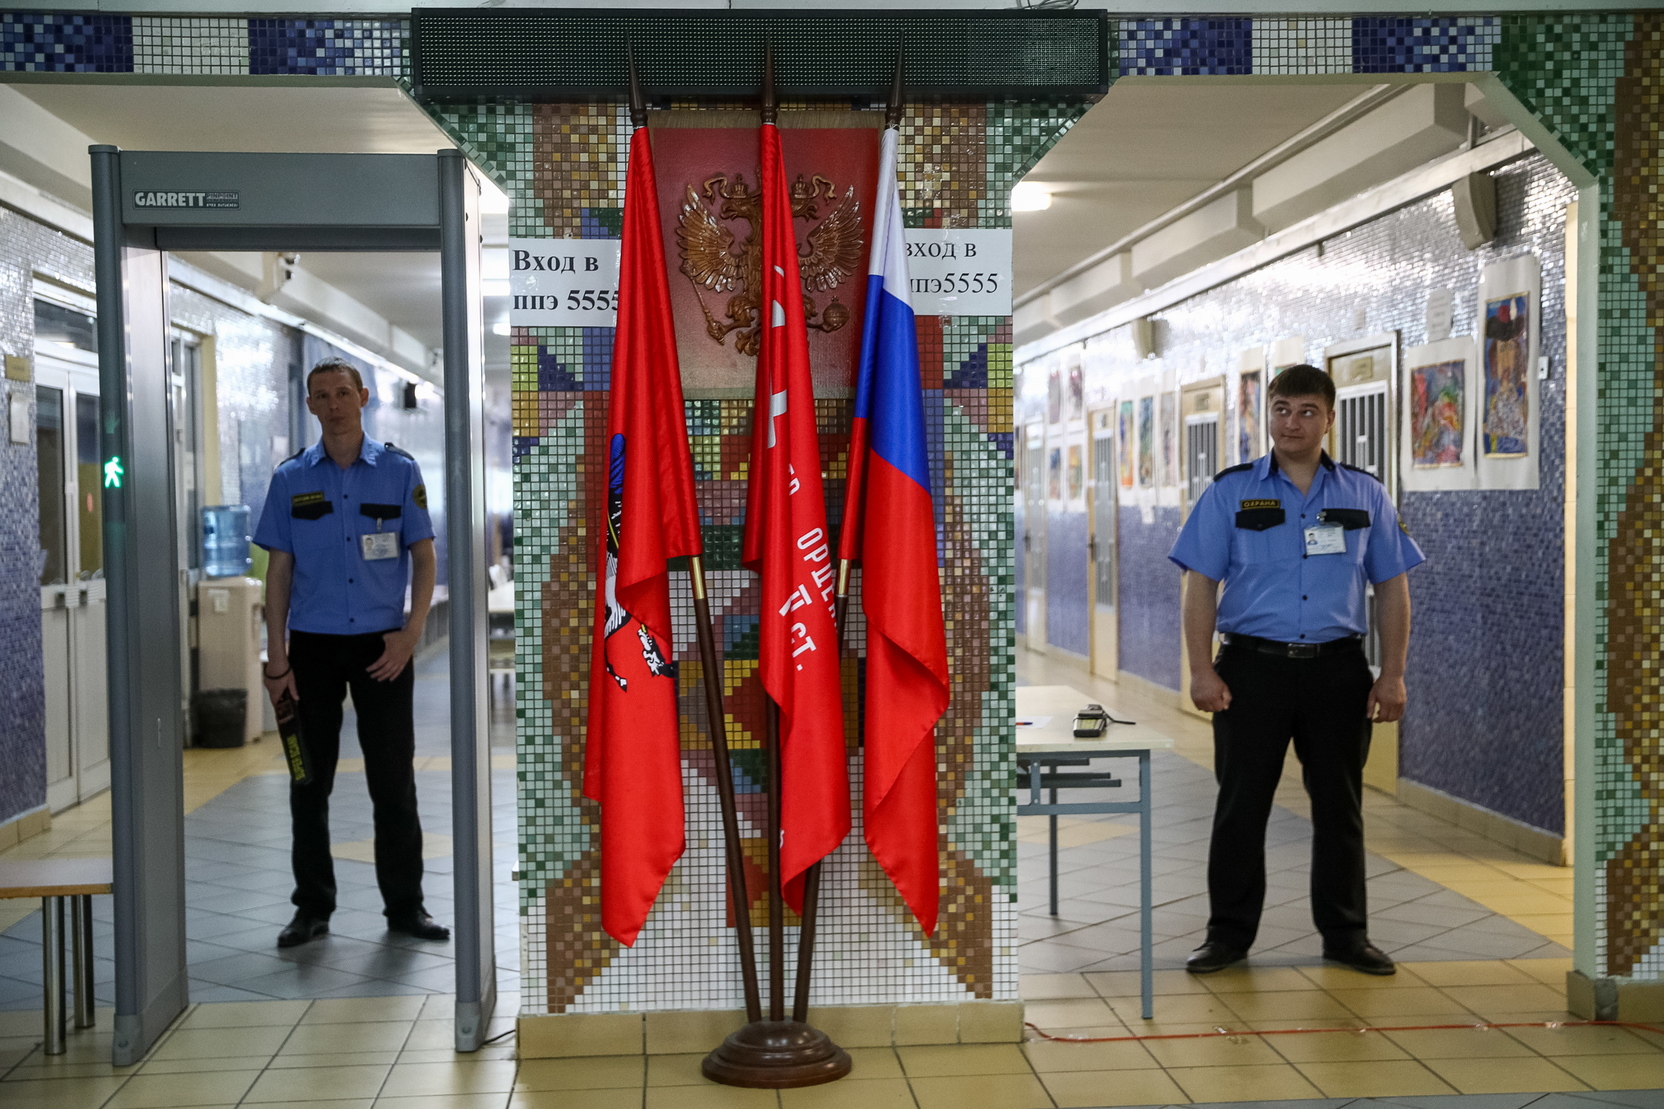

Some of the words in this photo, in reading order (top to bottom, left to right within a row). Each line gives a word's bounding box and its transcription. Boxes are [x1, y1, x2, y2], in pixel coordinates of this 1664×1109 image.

[135, 192, 206, 207] GARRETT
[964, 242, 977, 258] в
[512, 249, 576, 275] Вход
[584, 256, 599, 272] в
[910, 272, 998, 294] пэ5555
[513, 294, 559, 310] ппэ
[1243, 500, 1277, 508] ОХРАНА
